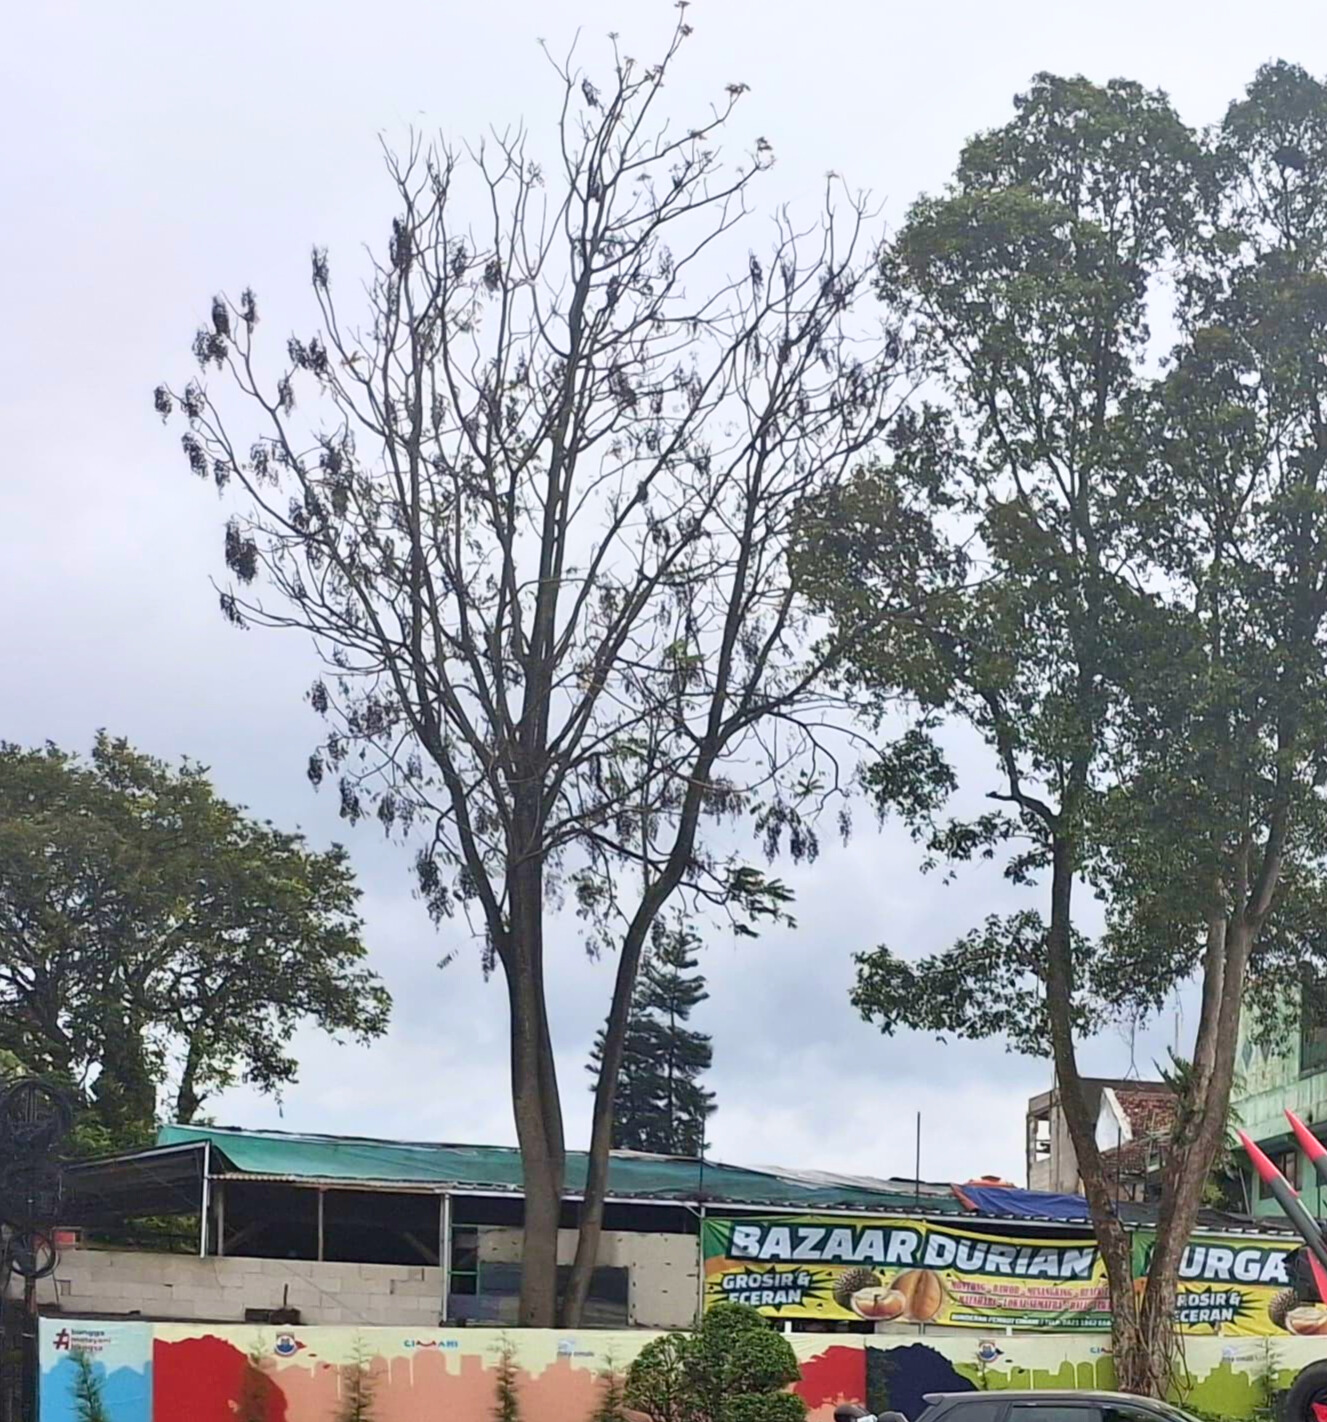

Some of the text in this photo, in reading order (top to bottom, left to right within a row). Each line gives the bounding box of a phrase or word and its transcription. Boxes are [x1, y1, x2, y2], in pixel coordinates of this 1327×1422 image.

[730, 1226, 1096, 1278] BAZAAR DURIAN
[1177, 1246, 1290, 1284] URGA
[722, 1271, 811, 1290] GROSIR &
[728, 1289, 803, 1305] ECERAN
[1176, 1292, 1227, 1307] ROSIR
